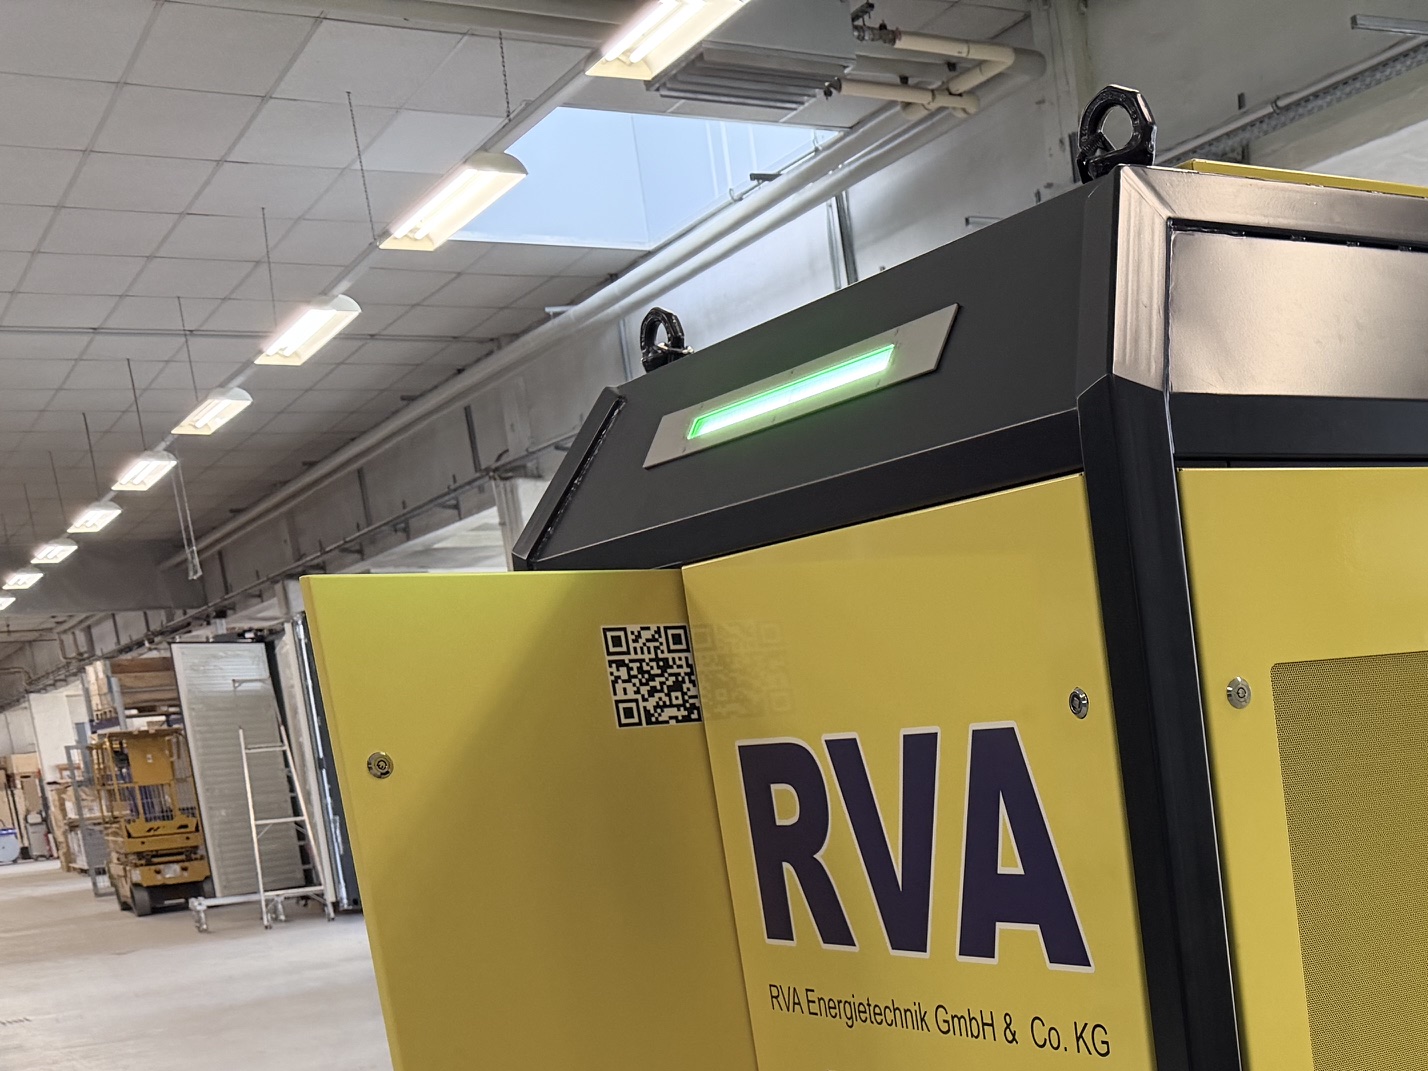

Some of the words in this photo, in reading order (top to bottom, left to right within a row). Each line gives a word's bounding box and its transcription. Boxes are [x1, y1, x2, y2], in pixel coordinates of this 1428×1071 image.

[735, 721, 1095, 973] RVA
[768, 983, 805, 1015] RVA
[804, 987, 931, 1033] Energietechnik
[934, 1004, 997, 1042] GmbH
[1003, 1012, 1019, 1045] &
[1030, 1016, 1068, 1052] Co.
[1073, 1020, 1111, 1058] KG
